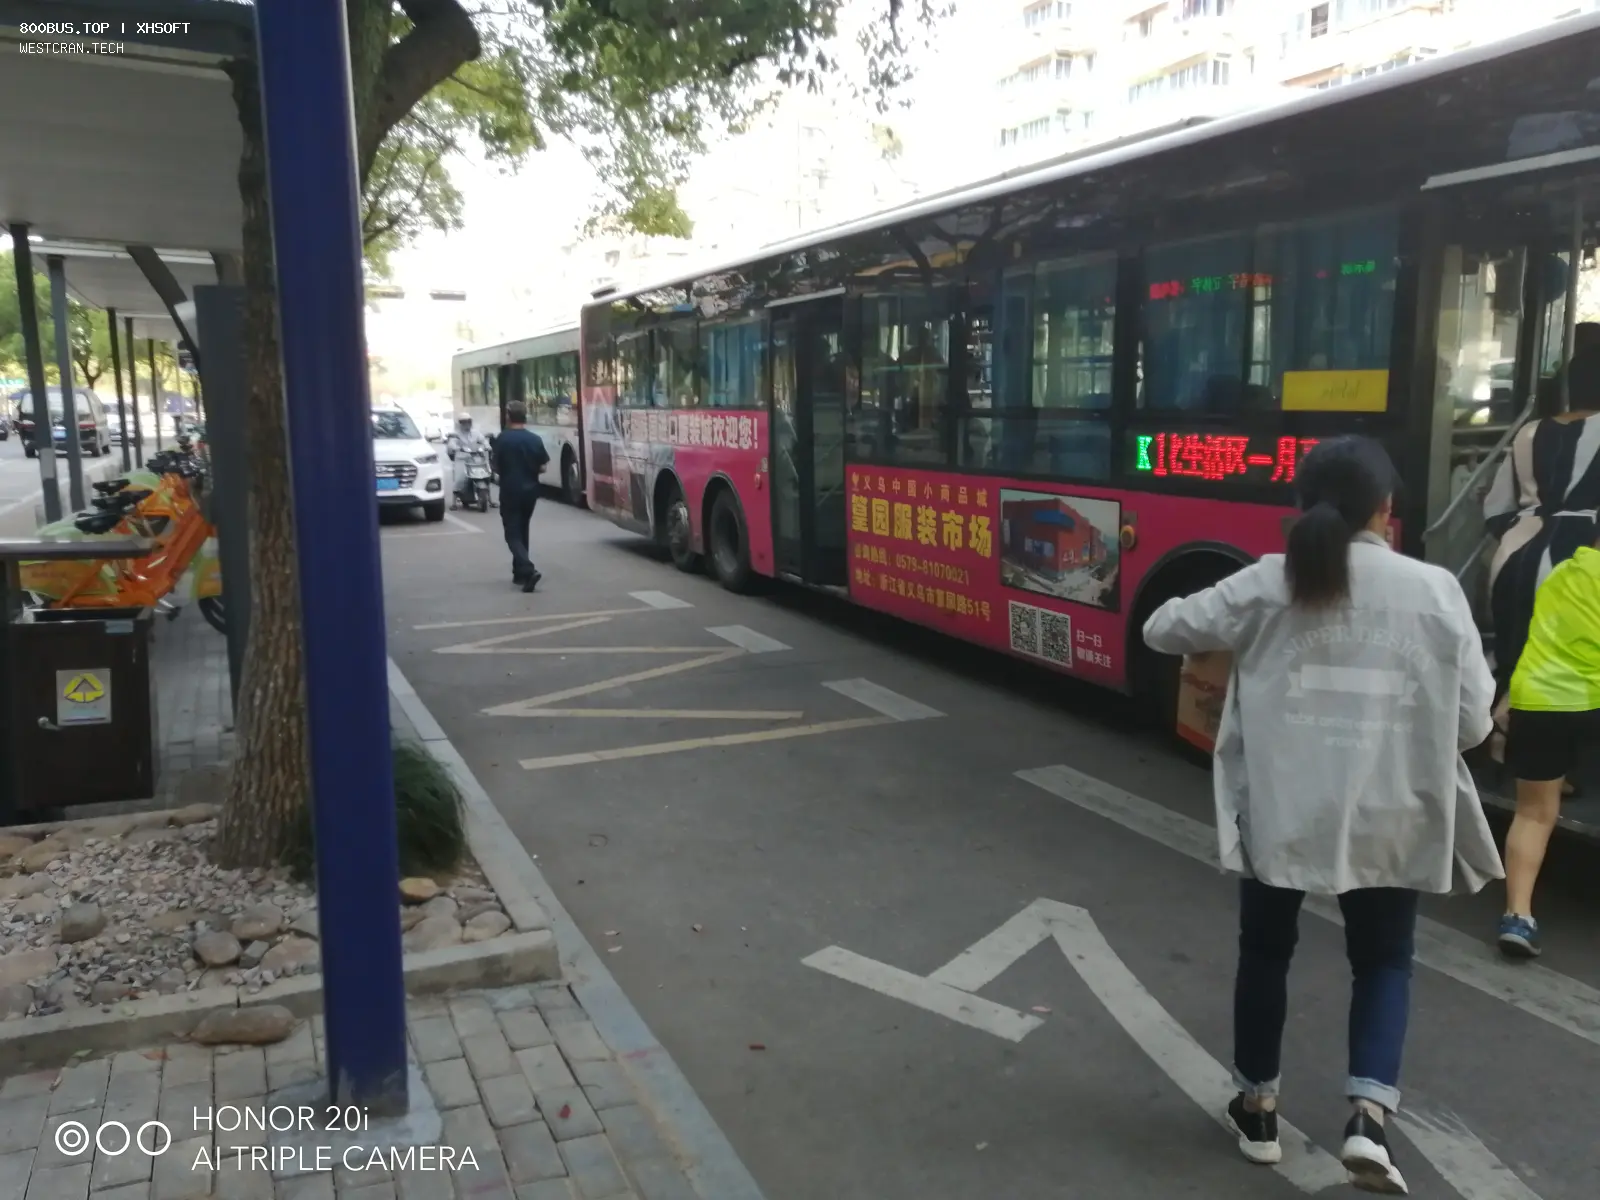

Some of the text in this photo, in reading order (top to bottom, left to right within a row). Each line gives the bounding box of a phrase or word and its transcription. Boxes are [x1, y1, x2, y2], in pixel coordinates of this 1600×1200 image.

[851, 494, 993, 558] 篁园服装市场
[1075, 629, 1102, 648] 扫一扫
